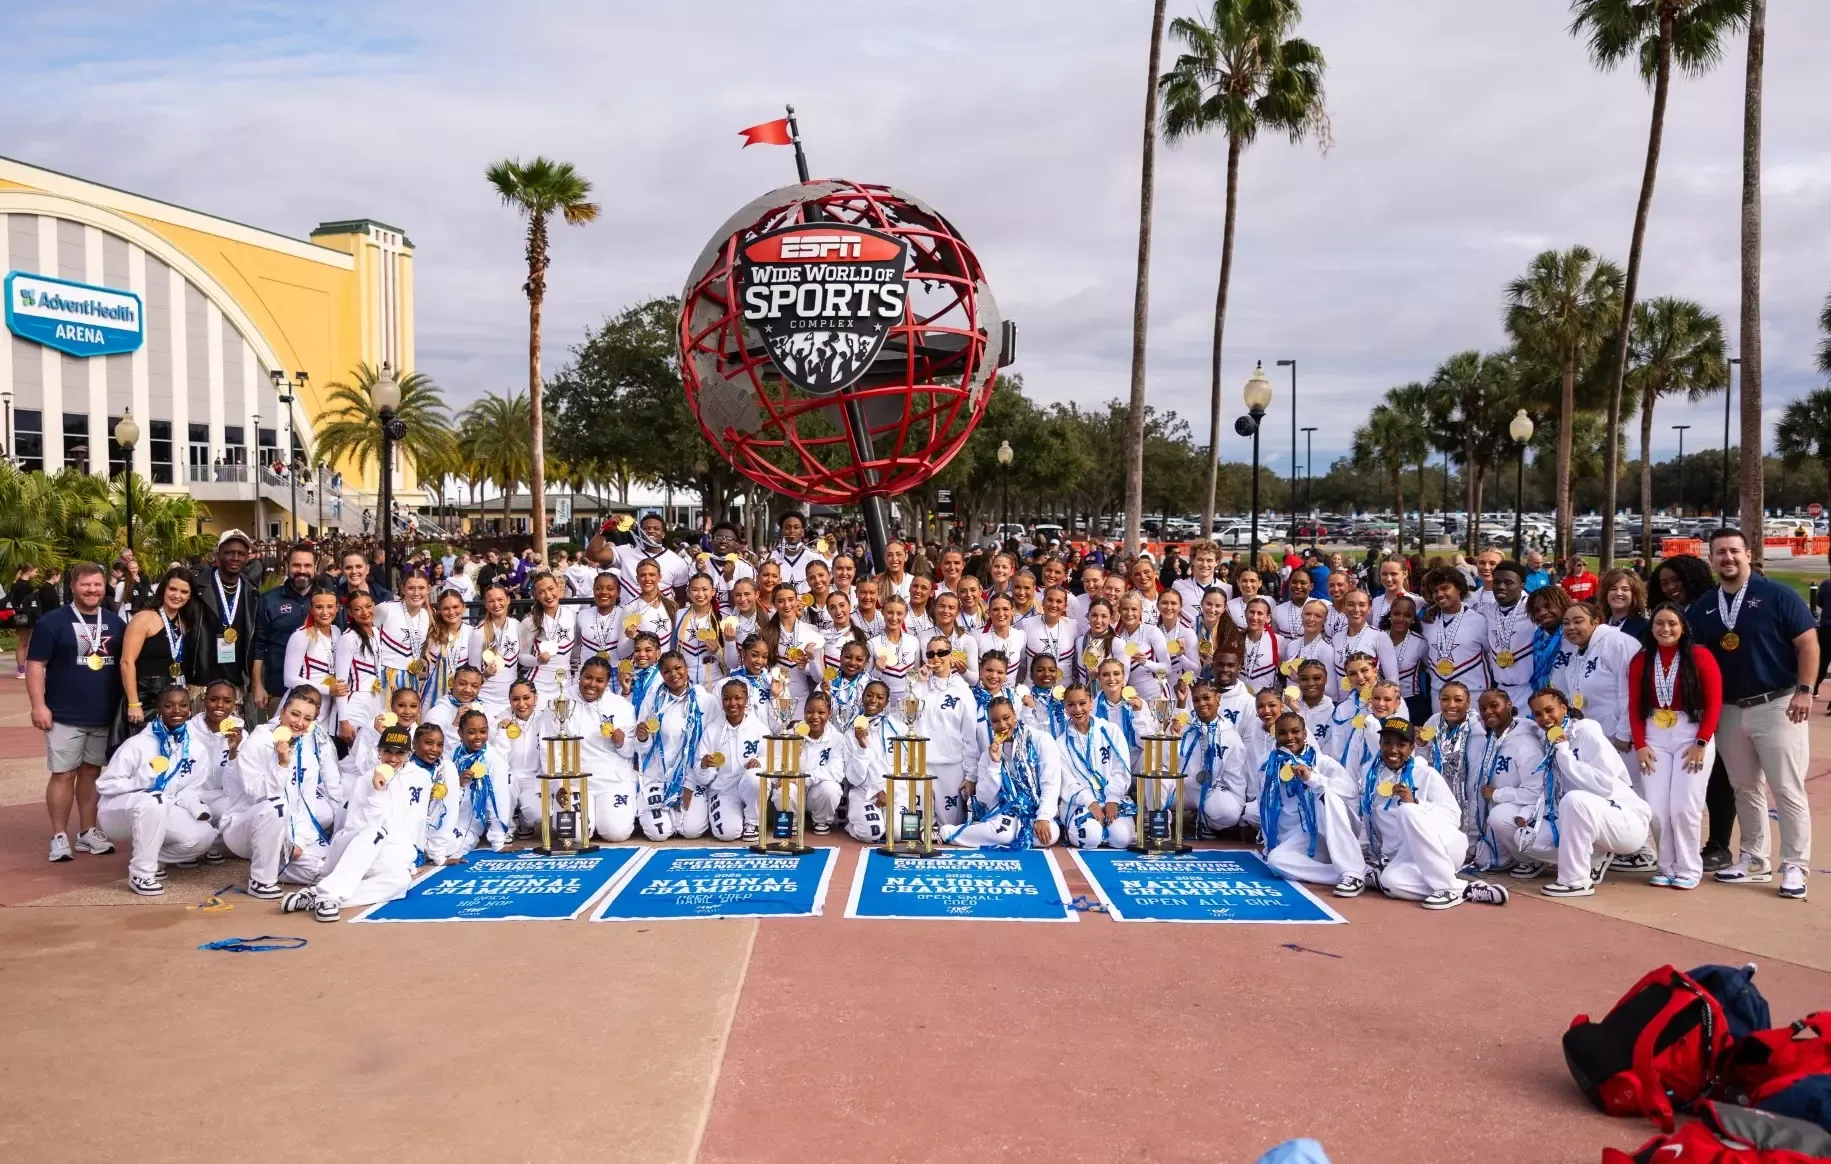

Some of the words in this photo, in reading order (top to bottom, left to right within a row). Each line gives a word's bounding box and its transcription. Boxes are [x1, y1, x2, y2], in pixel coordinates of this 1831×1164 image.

[780, 235, 862, 259] ESPN
[751, 266, 802, 284] WIDE
[804, 264, 872, 282] WORLD
[875, 268, 895, 282] OF
[744, 283, 904, 320] SPORTS
[38, 292, 134, 322] AdventHealth
[790, 319, 855, 329] COMPLEX
[55, 323, 105, 345] ARENA
[436, 878, 582, 888] NATIONAL
[648, 878, 797, 888] NATIONAL
[885, 877, 1035, 888] NATIONAL
[1120, 880, 1272, 889] NATIONAL
[421, 886, 581, 896] CHAMPIONS
[639, 885, 799, 895] CHAMPIONS
[881, 885, 1039, 895] CHAMPIONS
[1123, 887, 1283, 897] CHAMPIONS
[1136, 898, 1189, 906] OPEN
[1200, 898, 1239, 906] ALL
